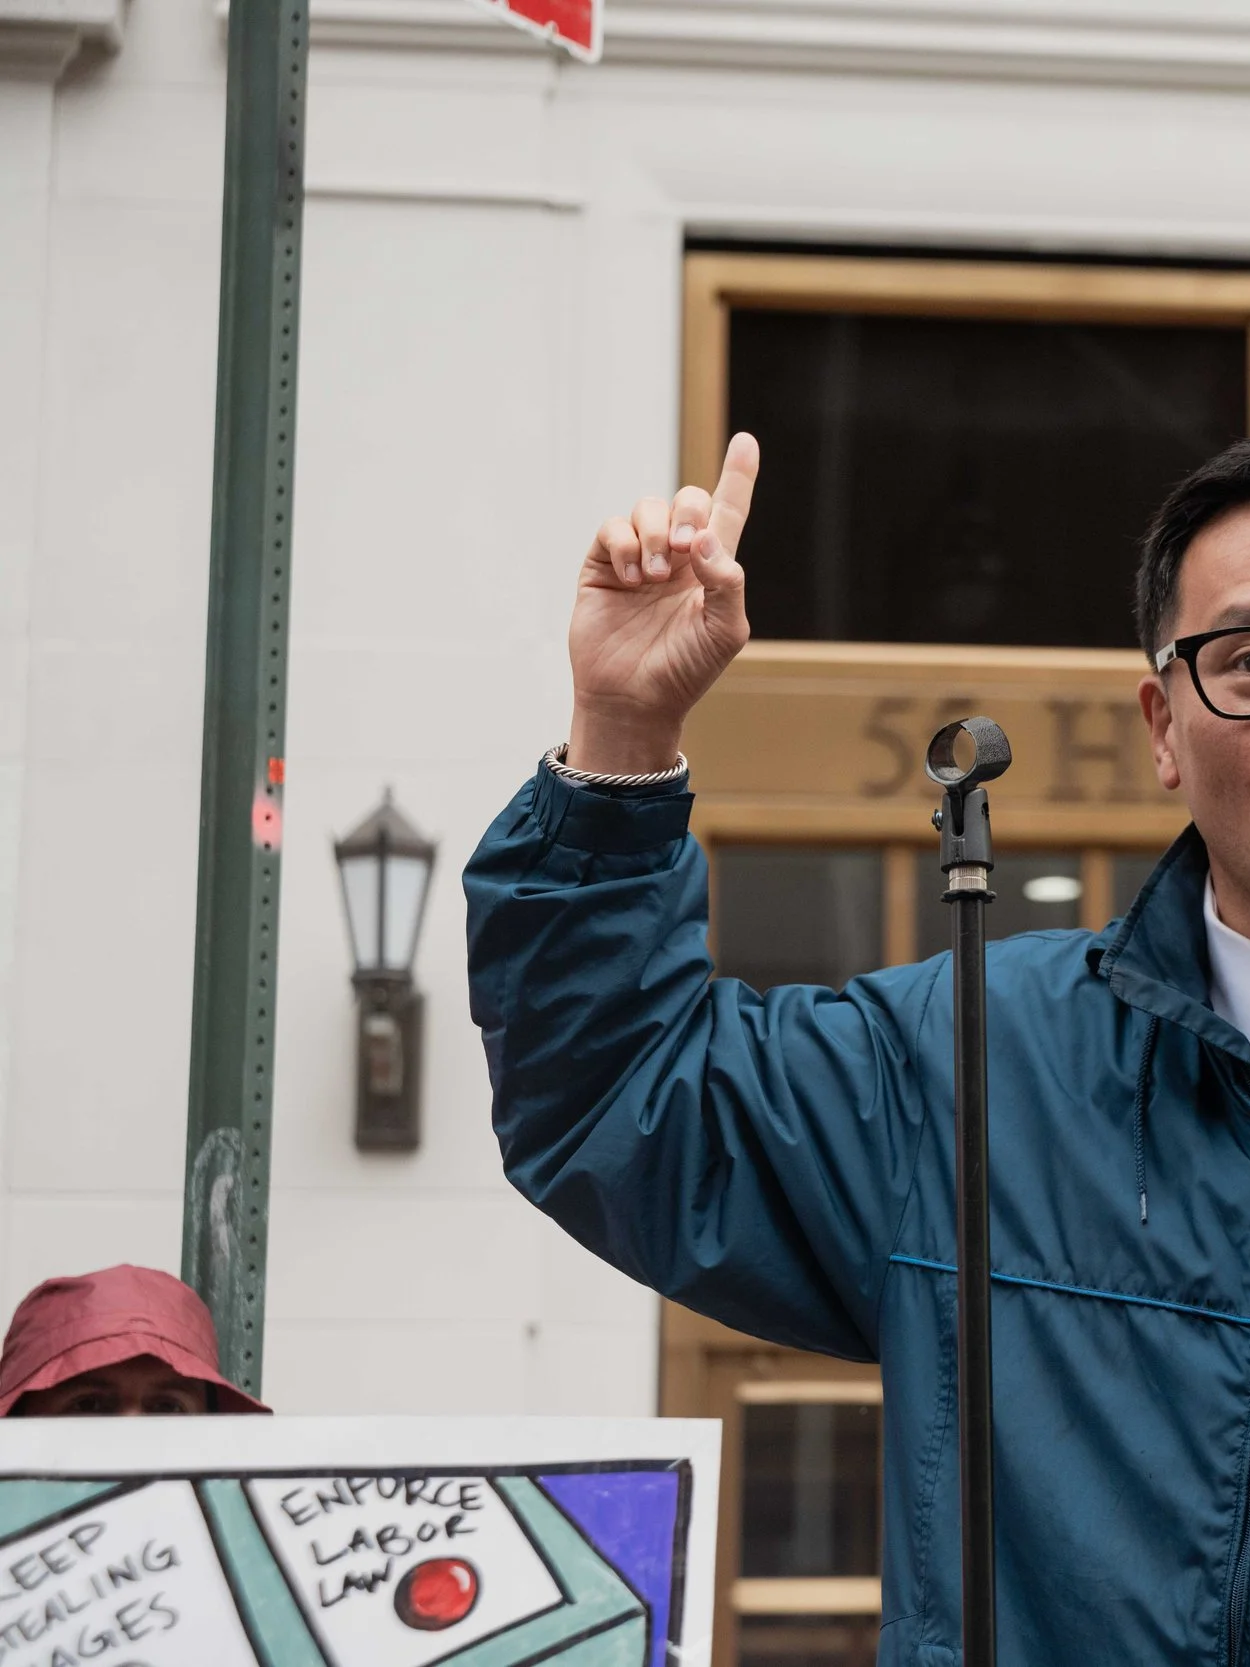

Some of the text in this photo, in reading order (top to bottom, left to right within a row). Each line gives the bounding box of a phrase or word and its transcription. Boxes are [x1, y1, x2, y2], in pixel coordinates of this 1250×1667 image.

[281, 1477, 484, 1526] ENFORCE
[310, 1512, 478, 1565] LABOR
[0, 1539, 182, 1652] TEALING
[28, 1591, 179, 1667] AGES
